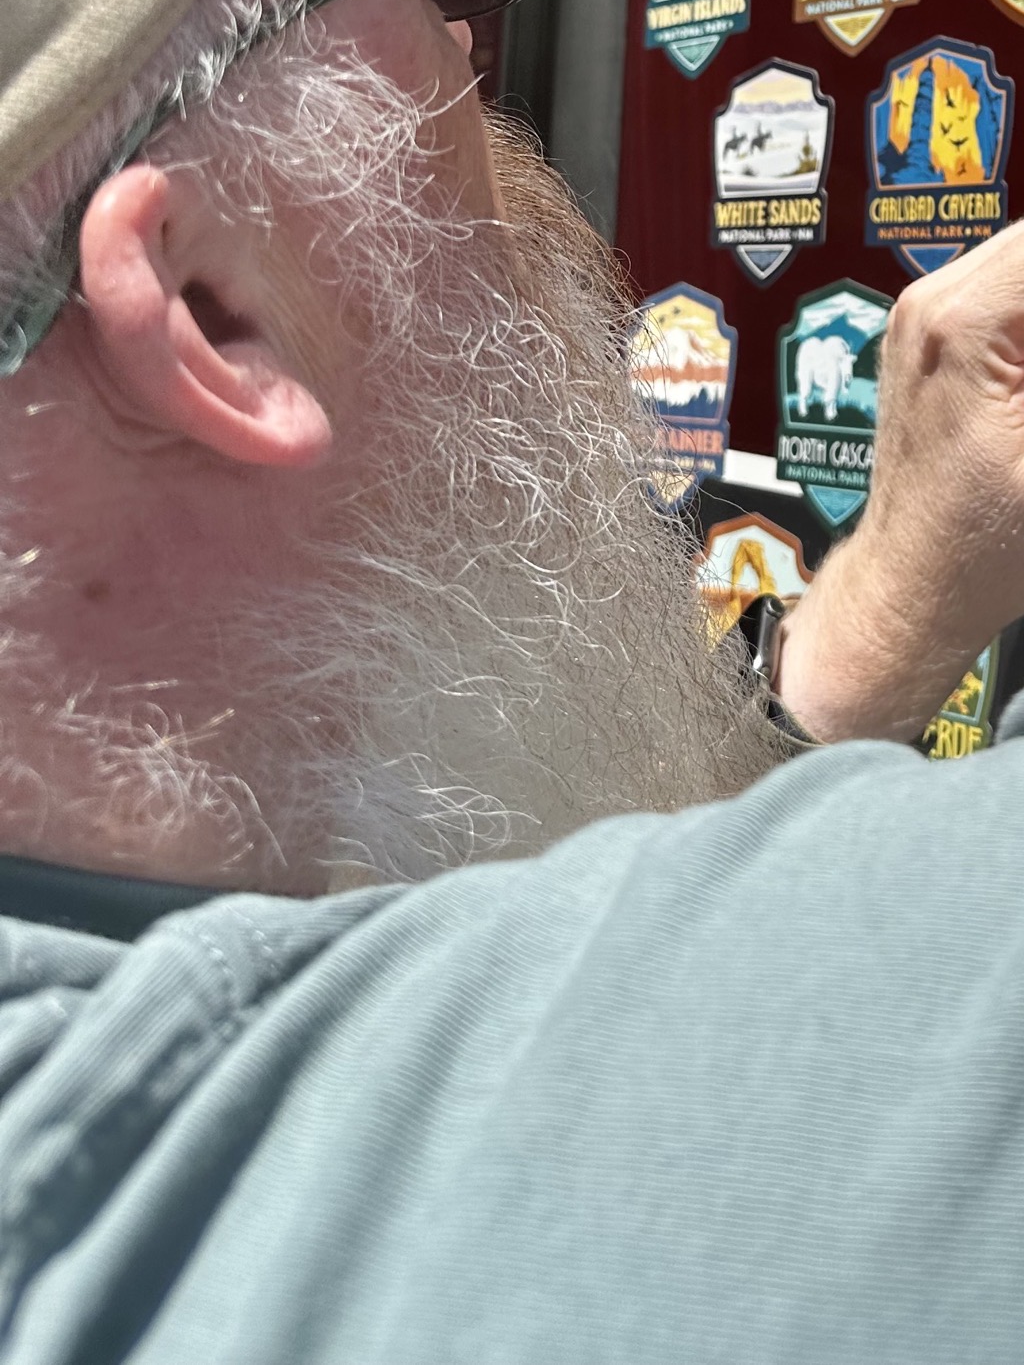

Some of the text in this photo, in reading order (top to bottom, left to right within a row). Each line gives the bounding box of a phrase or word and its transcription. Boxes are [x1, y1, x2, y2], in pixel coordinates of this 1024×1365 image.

[647, 1, 693, 30] VIRGIN
[714, 198, 821, 228] WHITE SANDS
[869, 192, 1000, 224] CARLSBAD CAVERNS
[718, 229, 765, 243] NATIONAL
[766, 228, 791, 241] PARK
[877, 225, 992, 239] NATIONAL PARK NM
[778, 434, 875, 470] NORTH CASCA
[785, 465, 867, 486] NATIONAL PARK
